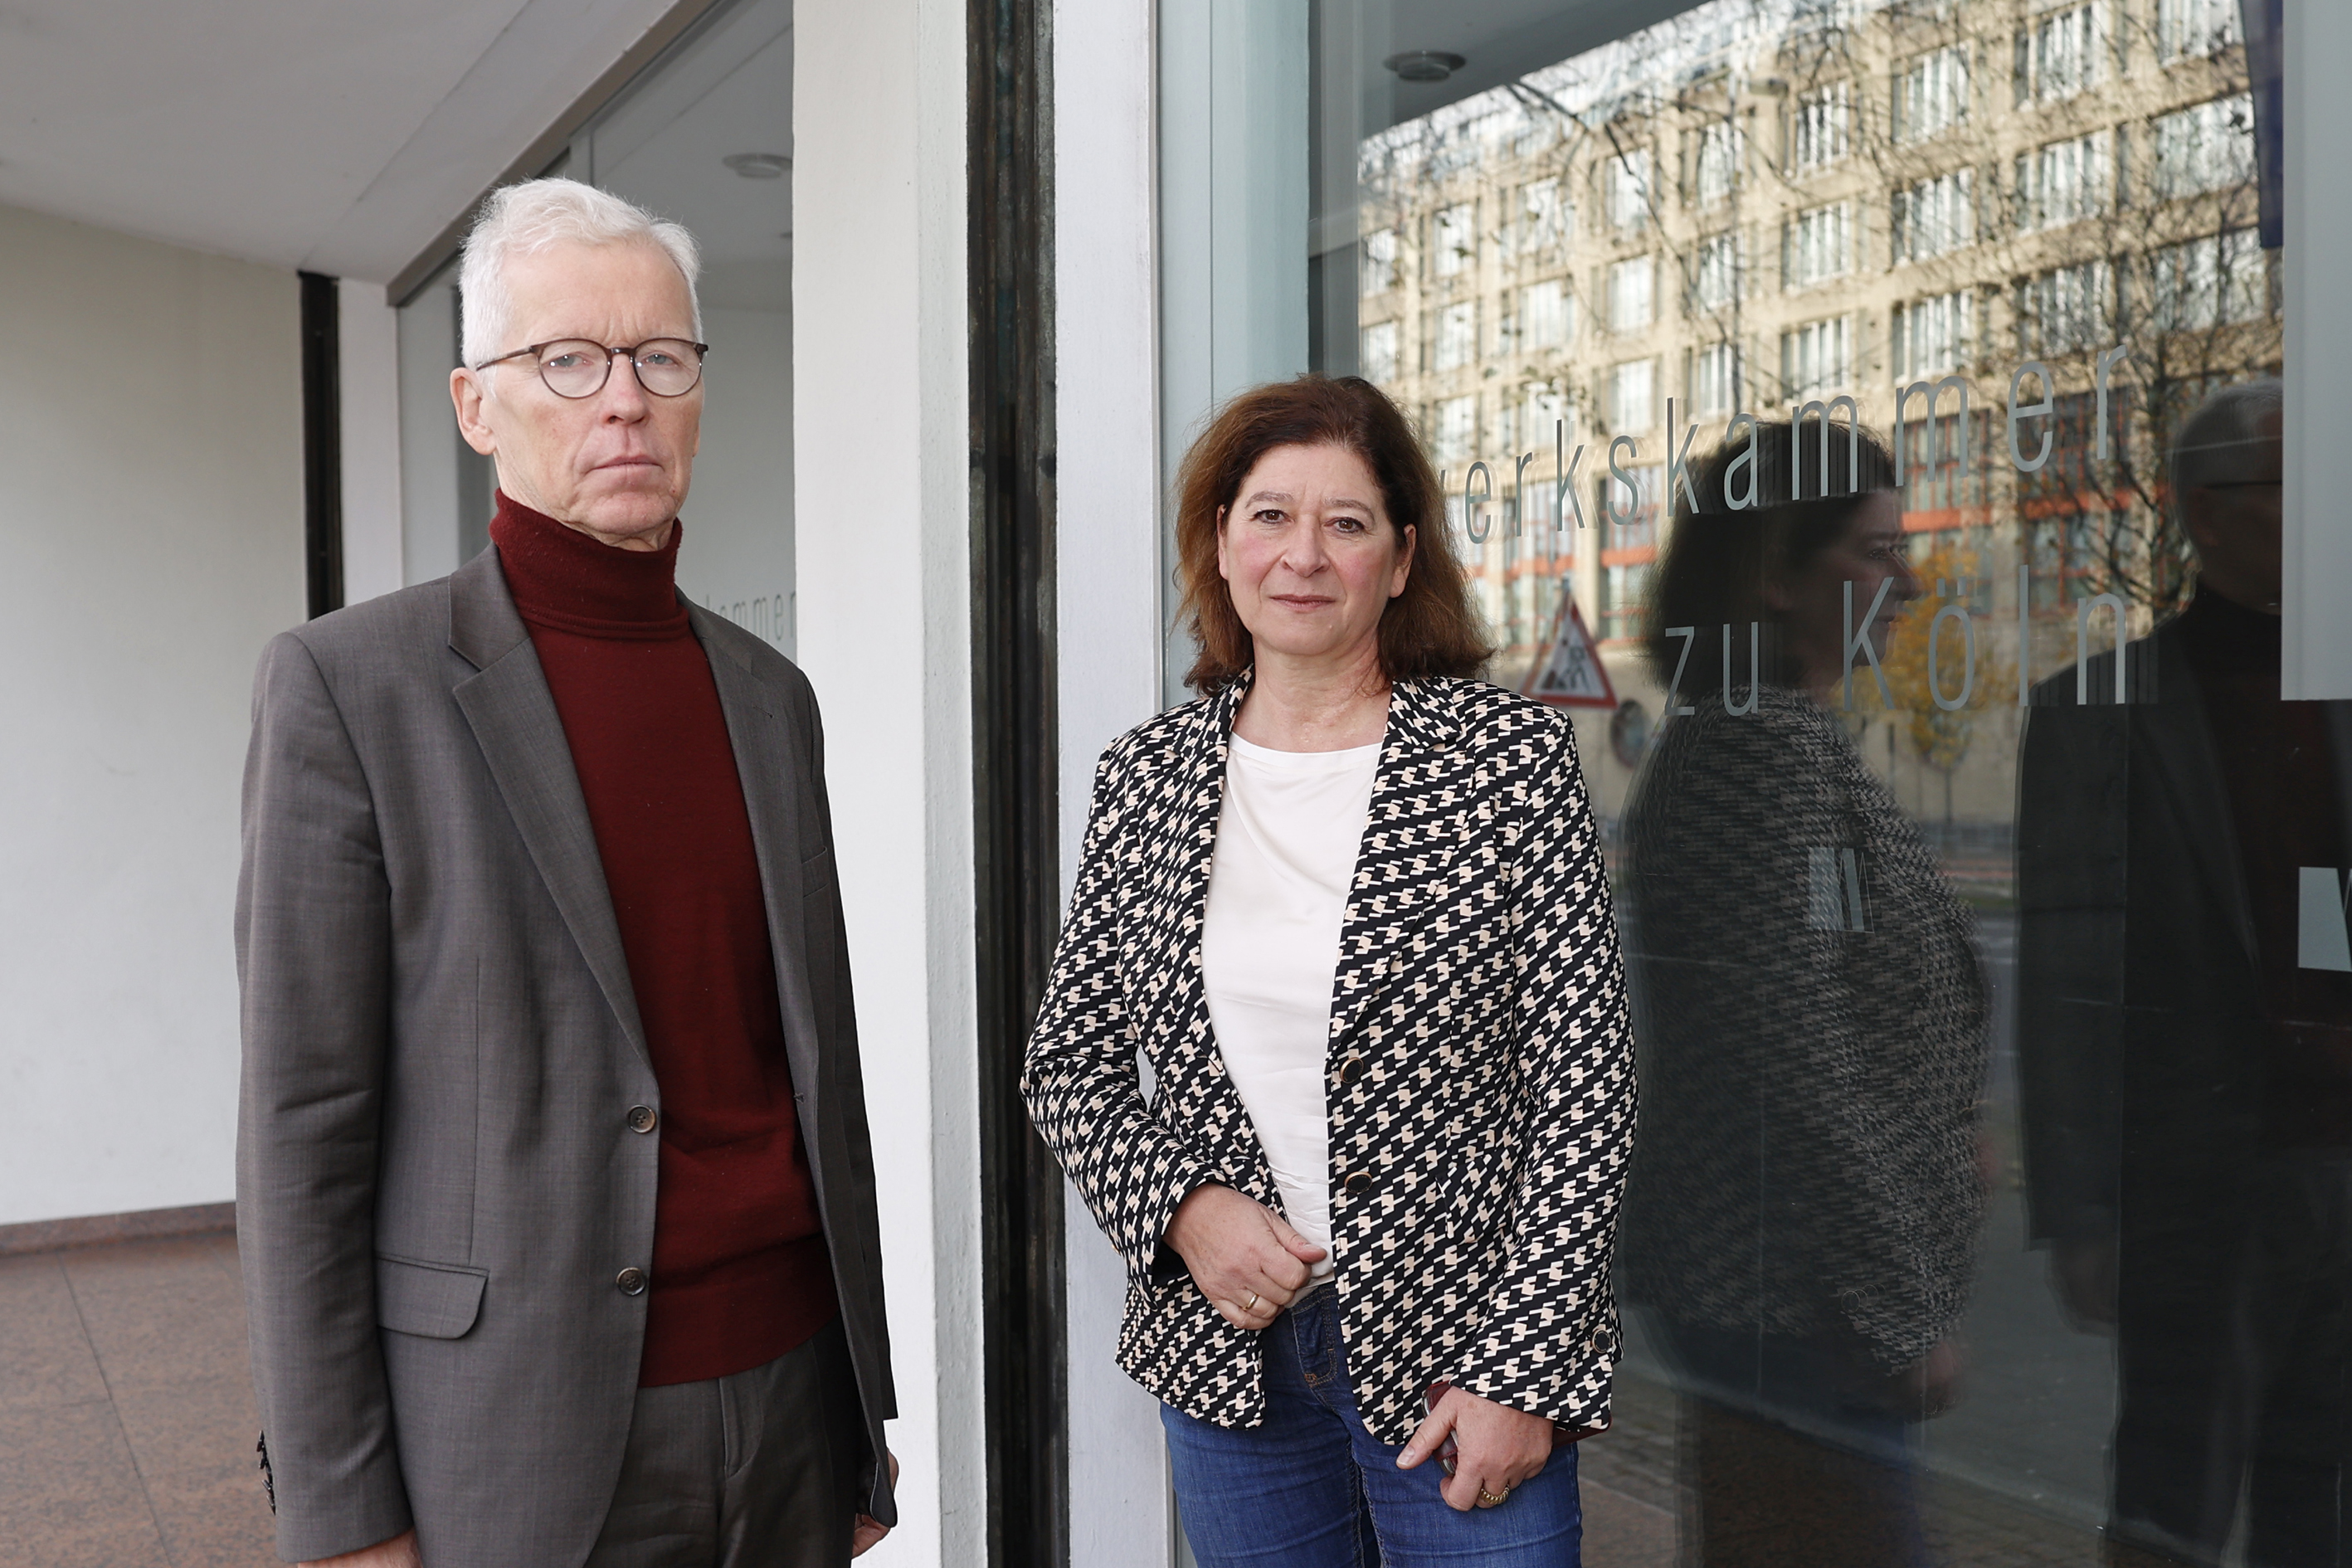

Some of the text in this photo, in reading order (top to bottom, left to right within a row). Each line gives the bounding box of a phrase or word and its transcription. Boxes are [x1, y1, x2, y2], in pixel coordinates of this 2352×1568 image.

[1440, 344, 2127, 544] erkskammer
[1664, 564, 2126, 717] zu Köln
